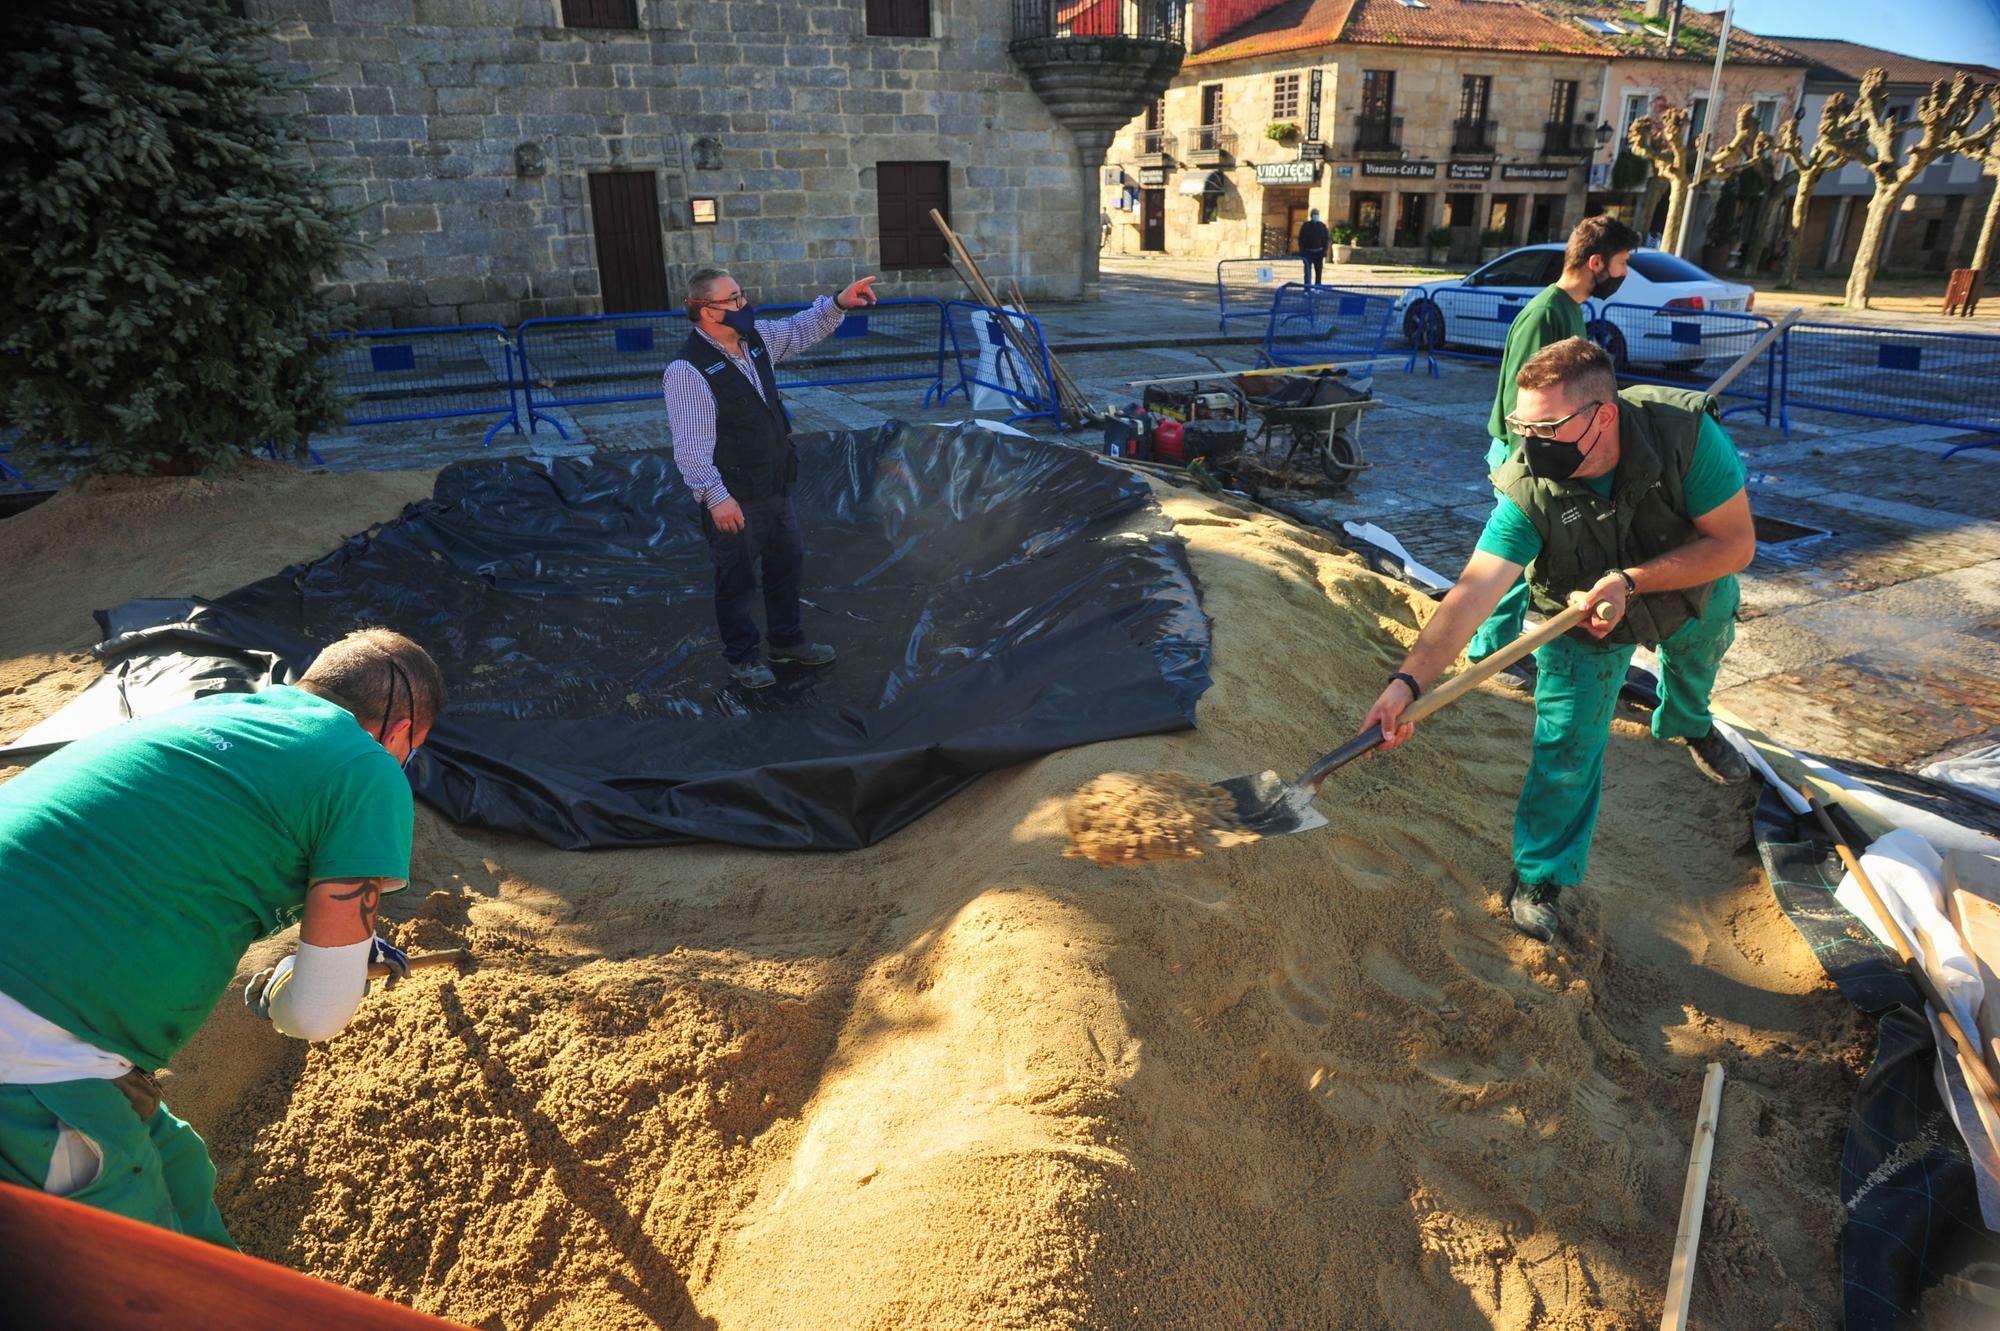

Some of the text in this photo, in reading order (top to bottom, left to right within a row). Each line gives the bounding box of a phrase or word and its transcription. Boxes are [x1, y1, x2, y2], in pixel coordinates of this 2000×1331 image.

[1312, 71, 1321, 97] Bar
[1257, 163, 1313, 177] VINOTECA
[1420, 165, 1435, 176] Bar
